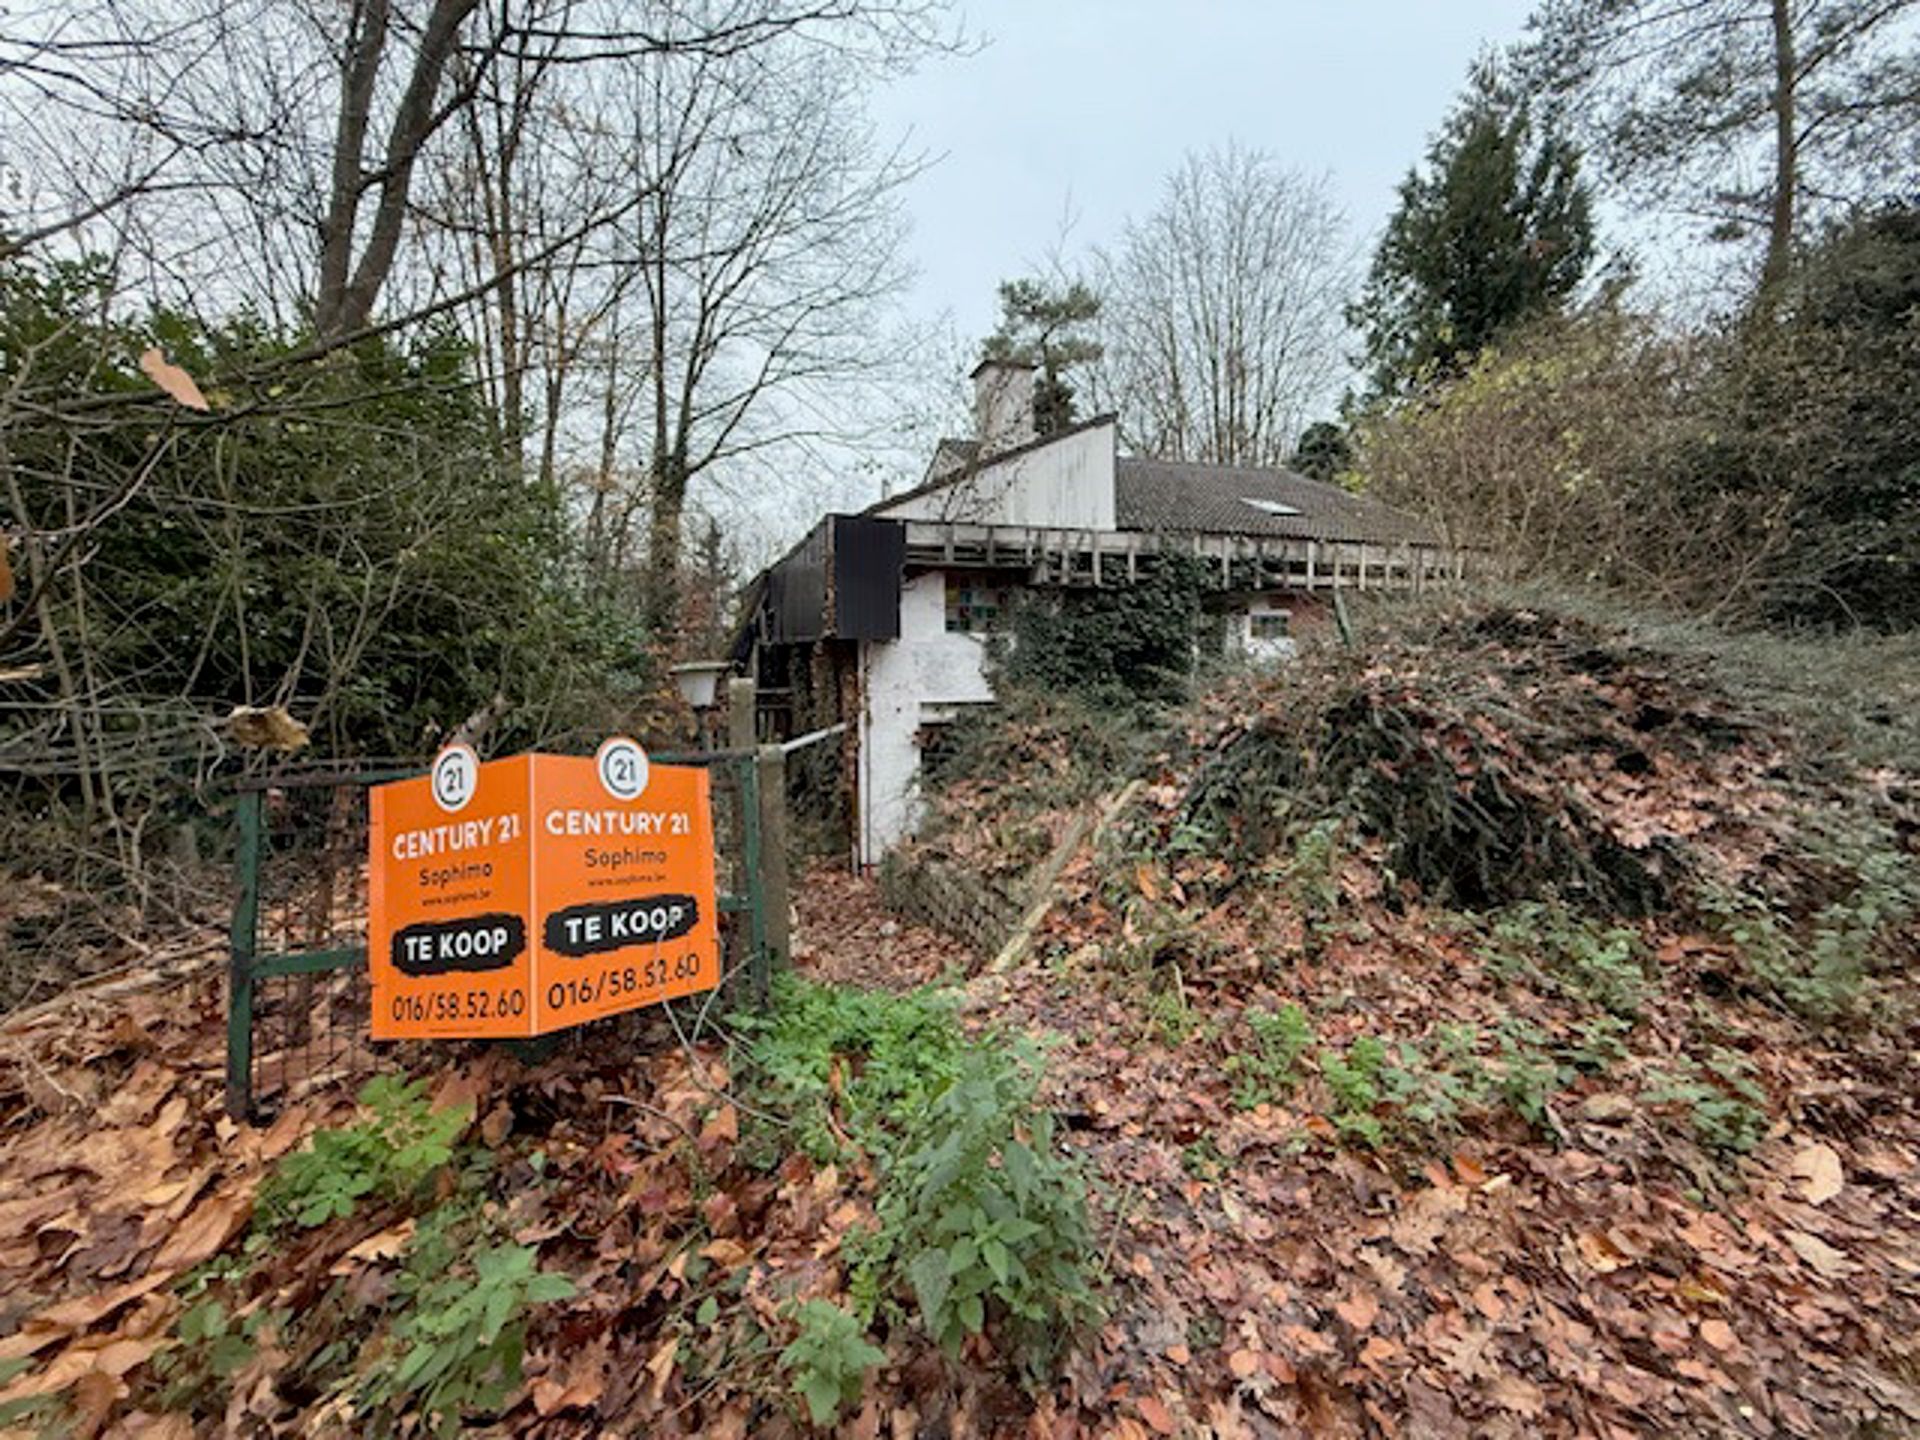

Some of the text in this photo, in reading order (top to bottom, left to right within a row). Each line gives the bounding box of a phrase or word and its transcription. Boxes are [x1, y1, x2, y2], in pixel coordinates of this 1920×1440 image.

[392, 813, 521, 860] CENTURY 21
[545, 810, 690, 835] CENTURY 21
[419, 861, 493, 889] Sophimo
[584, 847, 668, 871] Sophimo
[565, 907, 683, 944] TE KOOP
[405, 928, 507, 962] TE KOOP
[548, 954, 699, 1009] 016/58.52.60
[392, 989, 525, 1021] 016/58.52.60
